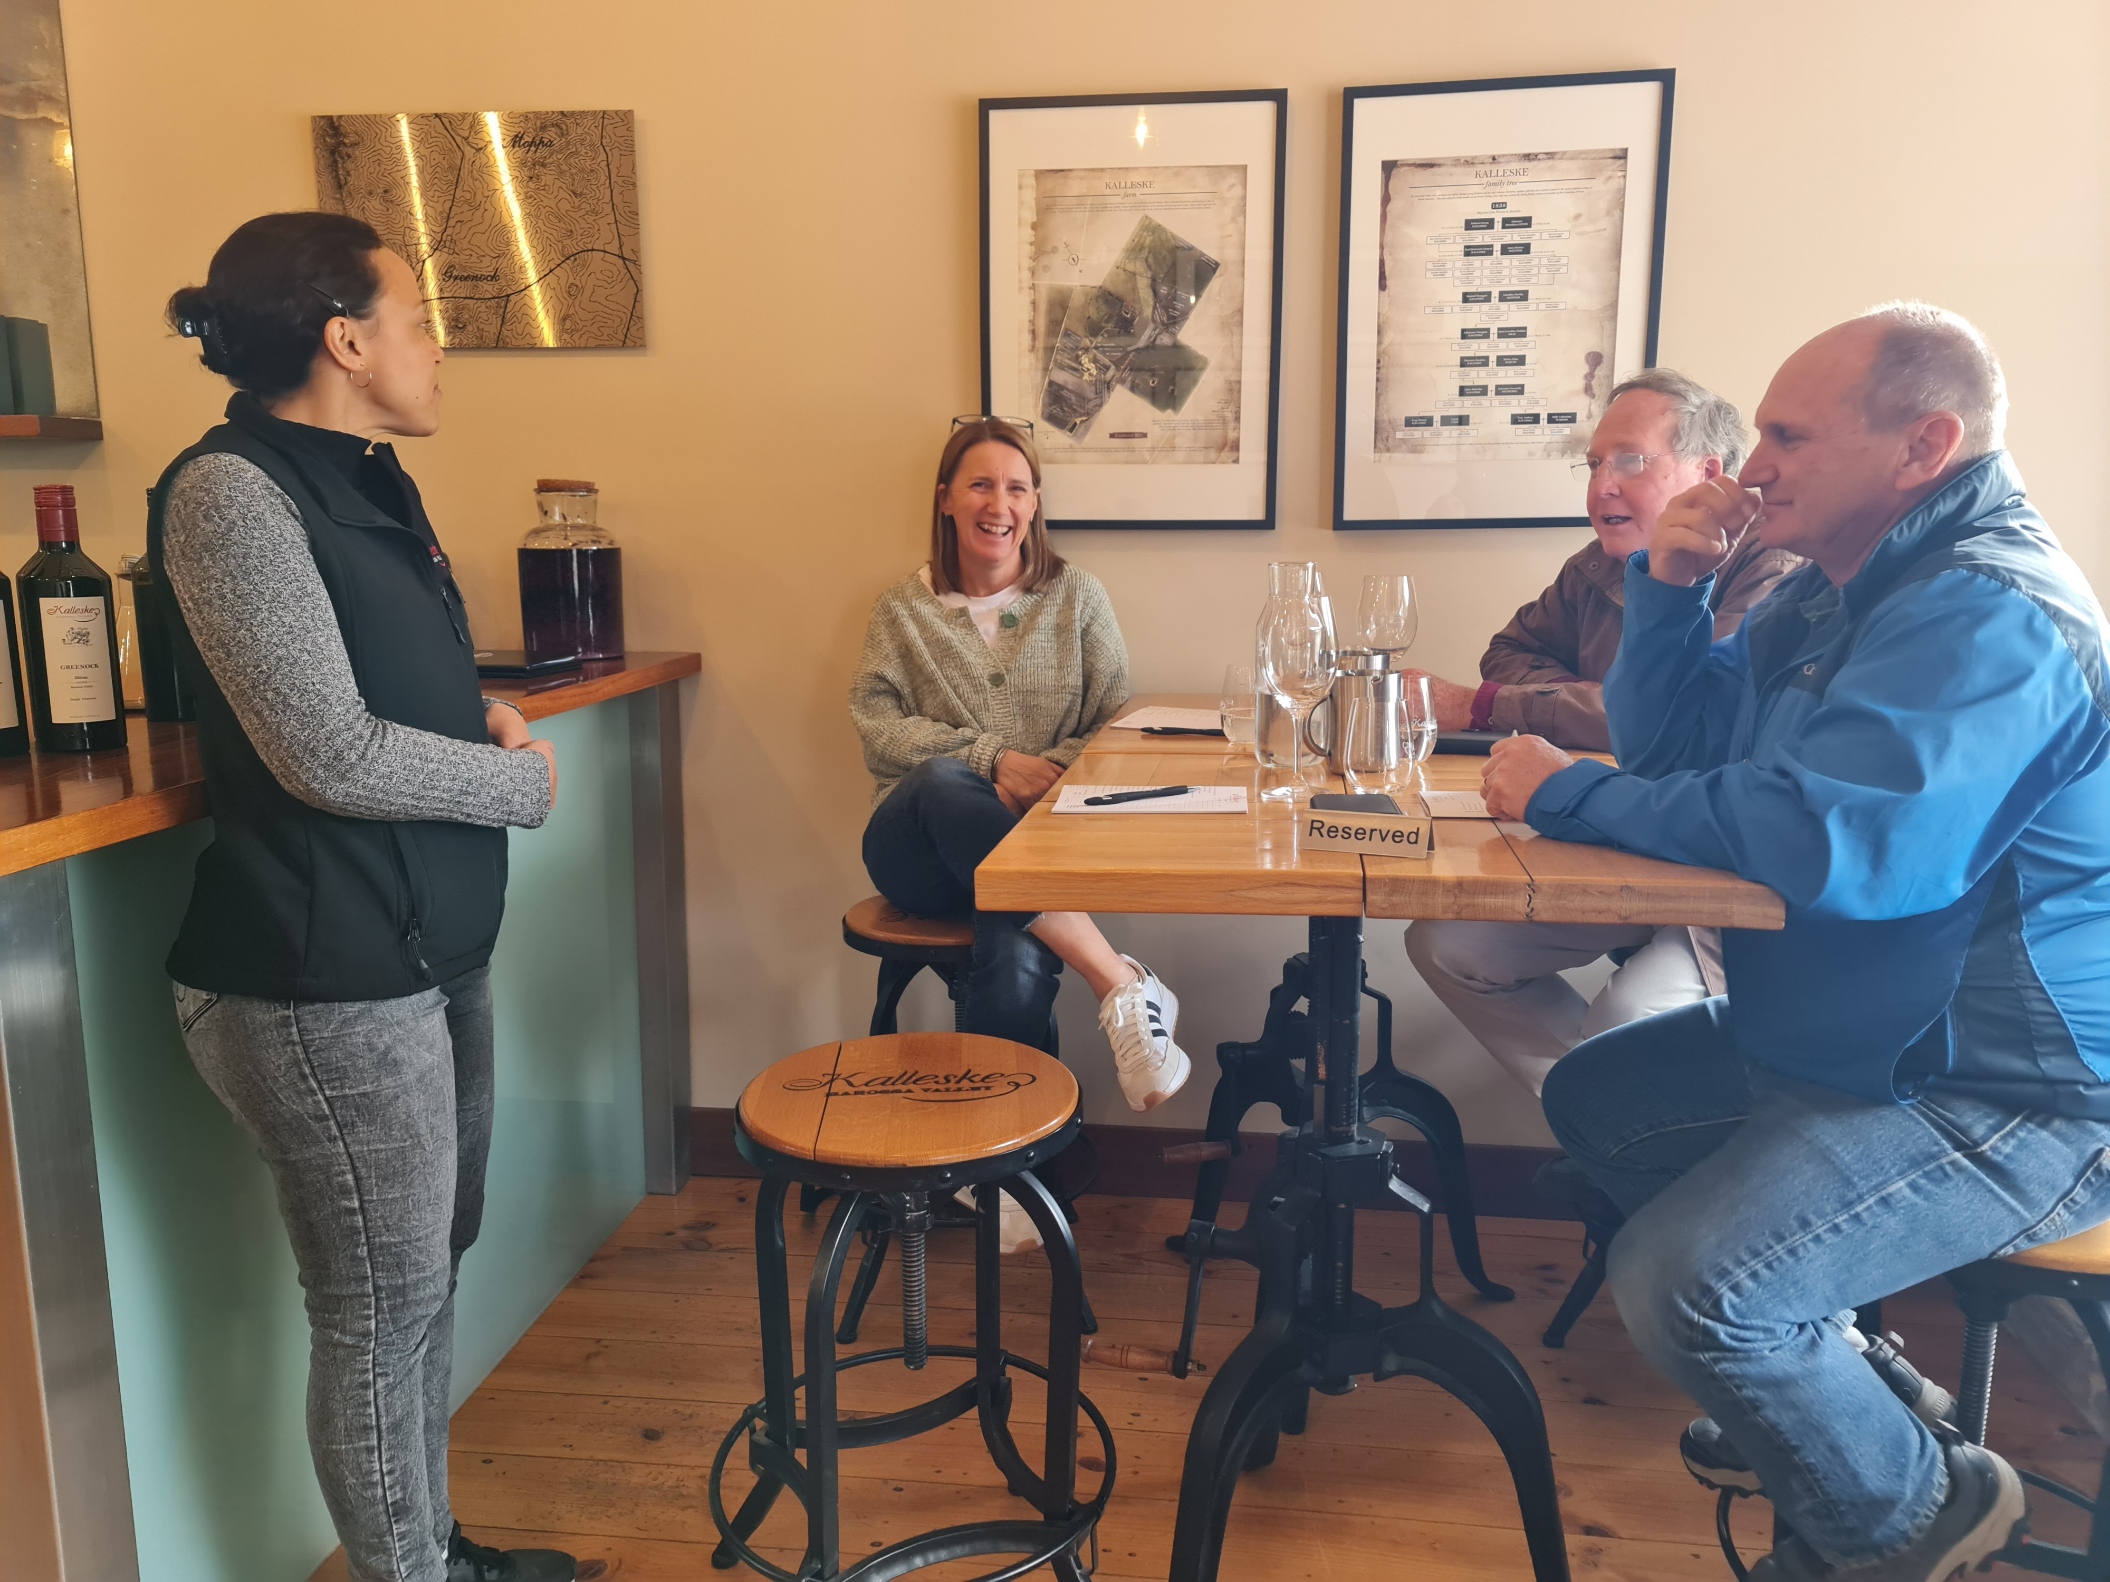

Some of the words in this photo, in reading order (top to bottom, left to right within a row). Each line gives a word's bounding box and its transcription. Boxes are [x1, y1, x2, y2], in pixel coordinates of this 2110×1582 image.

[507, 132, 555, 154] Moppa
[1475, 167, 1529, 179] KALLESKE
[1105, 180, 1156, 190] KALLESKE
[1483, 179, 1505, 189] family
[1121, 191, 1137, 199] farm
[443, 264, 500, 282] Greenock
[47, 605, 100, 616] Kalleske
[1309, 819, 1420, 845] Reserved
[783, 1068, 1036, 1092] Kalleske
[825, 1087, 914, 1097] BAROSSA
